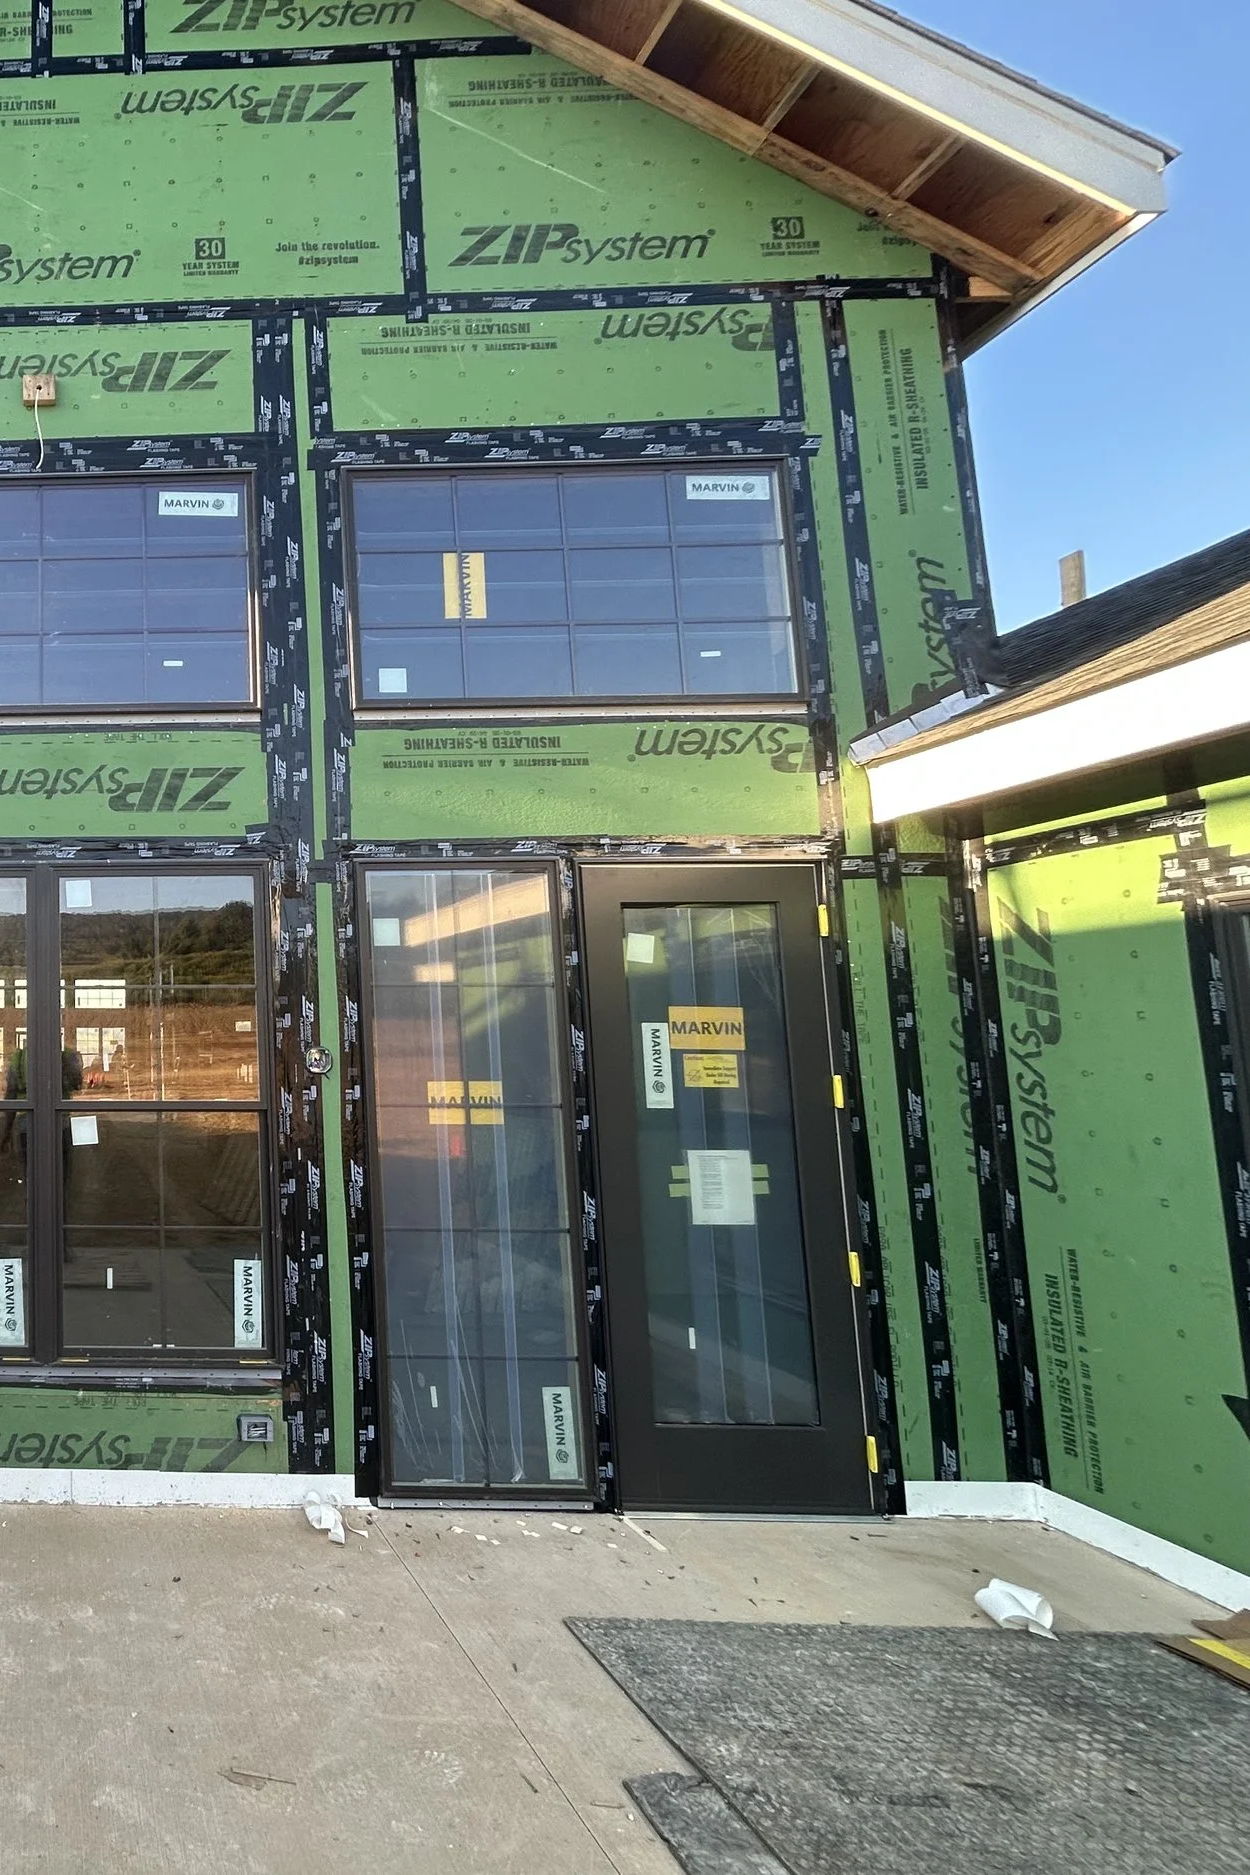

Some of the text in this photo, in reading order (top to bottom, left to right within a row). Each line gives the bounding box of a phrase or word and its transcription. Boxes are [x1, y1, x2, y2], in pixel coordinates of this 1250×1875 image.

[52, 8, 92, 17] ROTECTION
[0, 24, 74, 37] R-SHEING
[772, 218, 803, 239] 30
[196, 238, 224, 259] 30
[275, 240, 380, 252] Join the revolution.
[182, 260, 240, 271] YEAR SYSTEM
[380, 322, 531, 339] INSULATED R-SHEATHING
[899, 348, 920, 423] R-SHEATHING
[910, 427, 929, 490] INSULATED
[692, 482, 740, 494] MARVIN
[163, 499, 210, 510] MARVIN
[403, 735, 561, 751] INSULATED R-SHEATHING
[383, 759, 434, 770] PROTECTION
[438, 759, 474, 769] BARRIER
[478, 759, 492, 768] AIR
[513, 757, 590, 768] WATER-RESISTIVE
[671, 1020, 743, 1037] MARVIN
[650, 1027, 664, 1078] MARVIN
[4, 1263, 16, 1316] MARVIN
[243, 1265, 255, 1318] MARVIN
[1067, 1248, 1086, 1338] WATER-RESISTIVE
[1044, 1273, 1067, 1354] INSULATED
[1080, 1360, 1090, 1377] AIR
[1055, 1359, 1079, 1459] R-SHEATHING
[1082, 1383, 1096, 1429] BARRIER
[552, 1391, 567, 1448] MARVIN
[1087, 1431, 1105, 1495] PROTECTION
